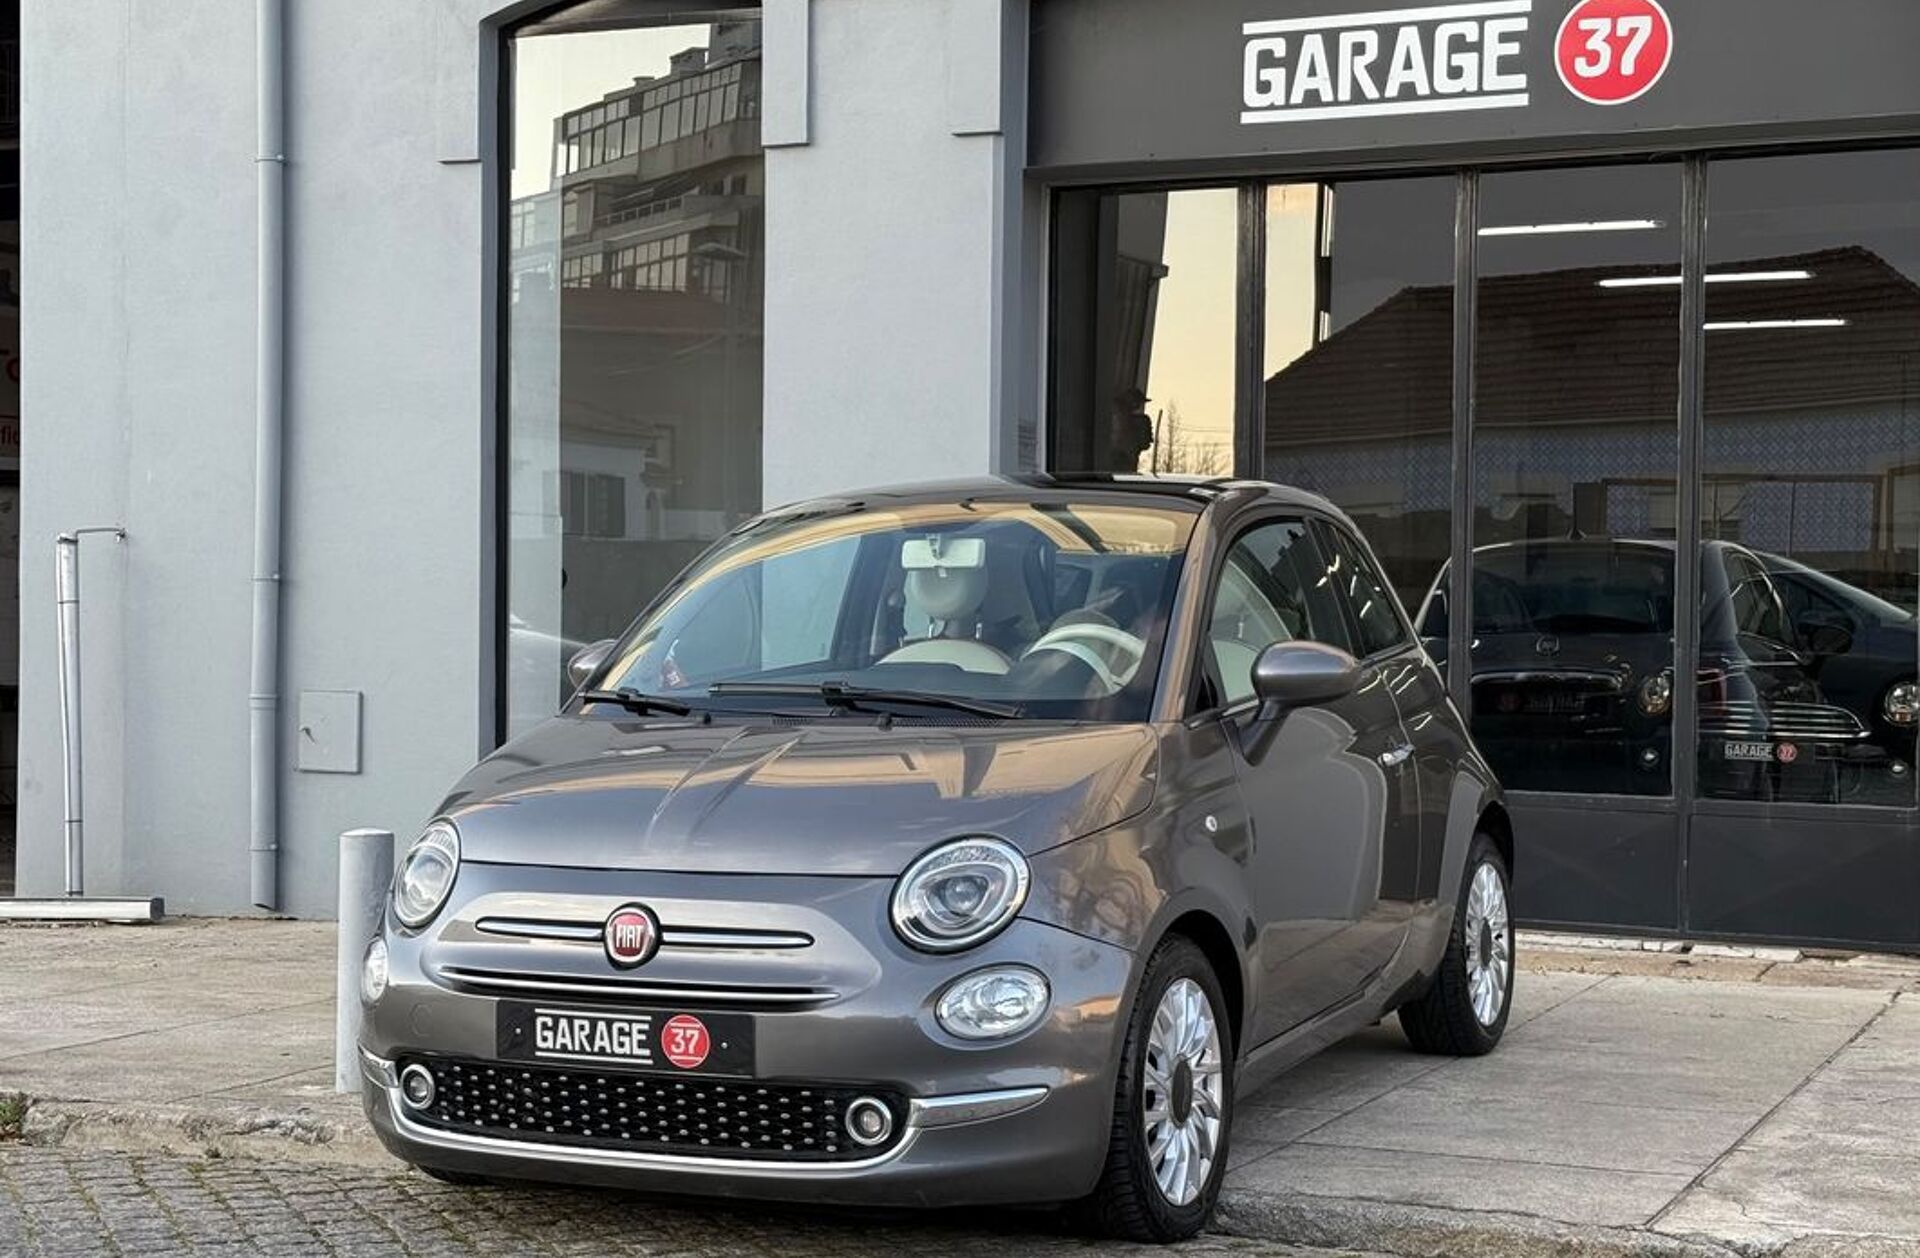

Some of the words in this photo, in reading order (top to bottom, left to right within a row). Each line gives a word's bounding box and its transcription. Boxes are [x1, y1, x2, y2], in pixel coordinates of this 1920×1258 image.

[1243, 17, 1528, 108] GARAGE
[1573, 15, 1653, 78] 37
[1725, 743, 1773, 758] GARAGE
[615, 924, 645, 949] FIAT
[535, 1016, 650, 1056] GARAGE
[671, 1028, 700, 1054] 37
